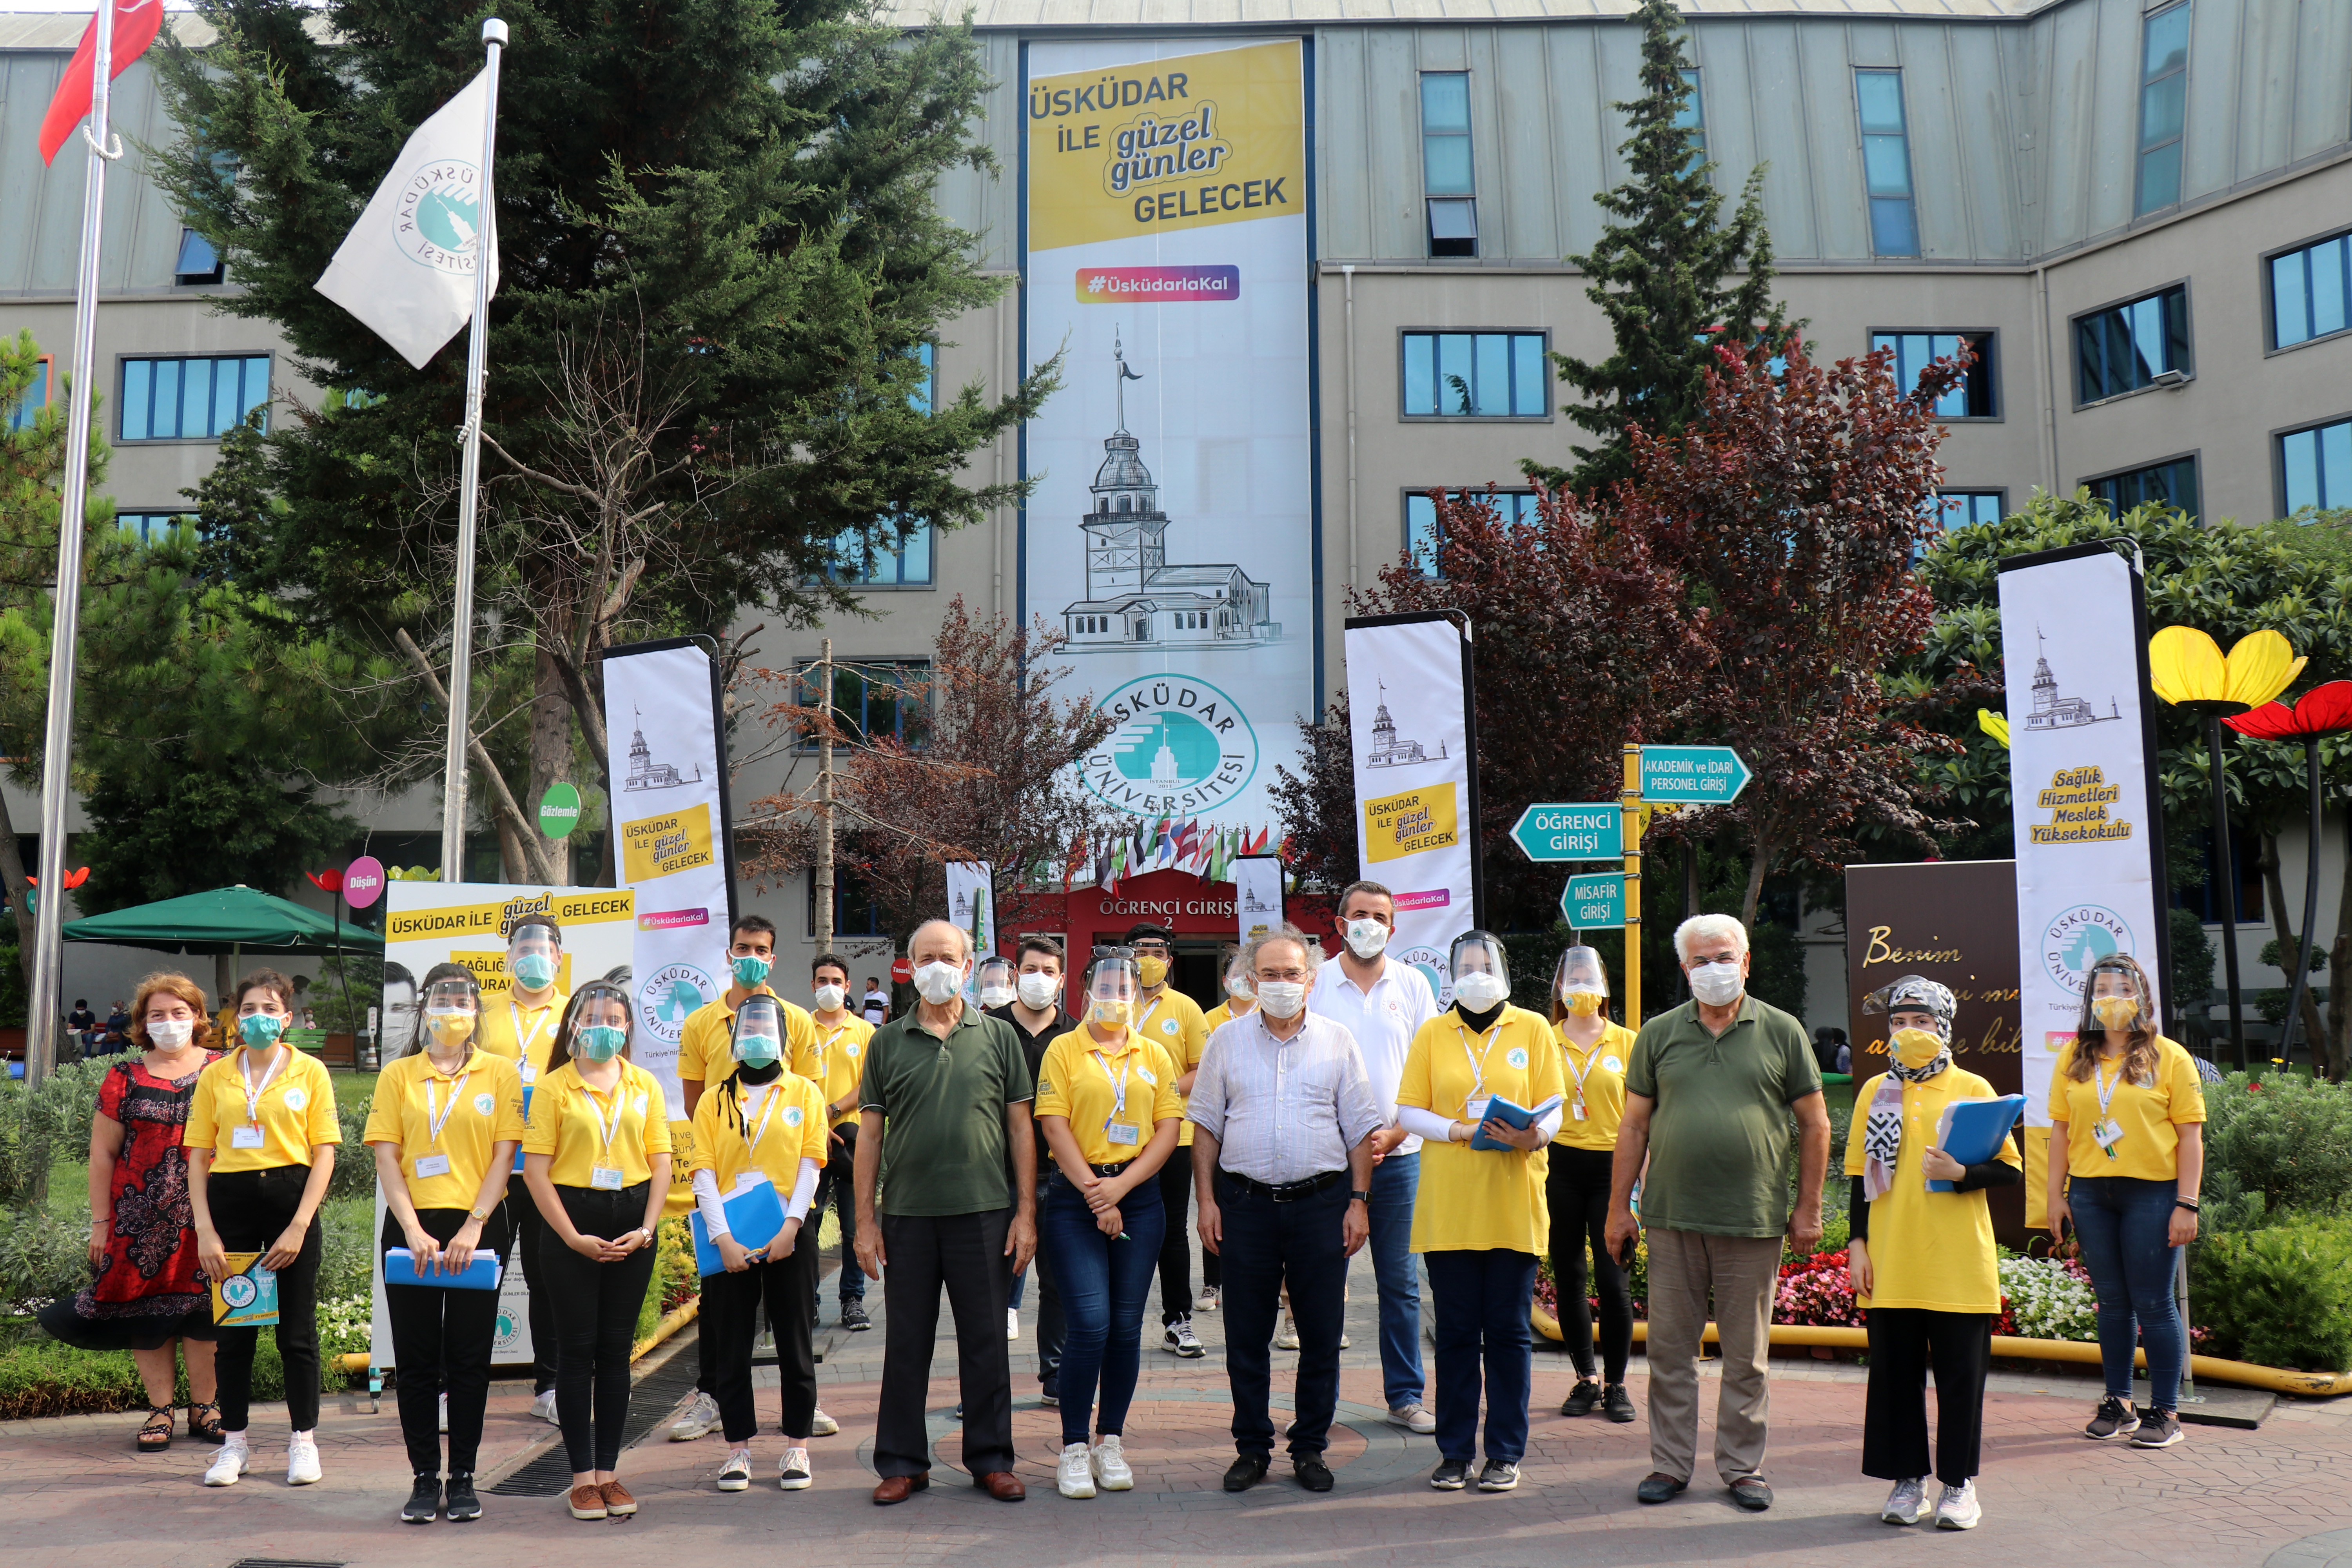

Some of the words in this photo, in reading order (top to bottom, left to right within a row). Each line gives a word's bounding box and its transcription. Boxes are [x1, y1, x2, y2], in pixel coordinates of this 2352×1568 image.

[1030, 72, 1188, 119] ÜSKÜDAR
[1058, 124, 1100, 152] İLE
[1116, 107, 1212, 160] güzel
[1111, 141, 1227, 191] günler
[1134, 177, 1287, 222] GELECEK
[1087, 276, 1228, 293] #ÜsküdarlaKal
[1644, 758, 1694, 773] AKADEMİK
[1695, 764, 1706, 773] ve
[1708, 759, 1733, 774] İDARİ
[1651, 777, 1699, 791] PERSONEL
[1700, 776, 1727, 794] GİRİŞİ
[2055, 769, 2102, 788] Sağlık
[1369, 795, 1419, 816] ÜSKÜDAR
[2040, 788, 2117, 806] Hizmetleri
[541, 804, 578, 818] Gözlemle
[1377, 817, 1392, 828] İLE
[1396, 806, 1428, 829] güzel
[1535, 812, 1611, 830] ÖĞRENCİ
[2055, 805, 2107, 823] Meslek
[626, 818, 678, 838] ÜSKÜDAR
[1396, 820, 1434, 842] günler
[2033, 822, 2129, 841] Yüksekokulu
[634, 839, 649, 849] İLE
[654, 828, 686, 851] güzel
[1404, 831, 1454, 851] GELECEK
[1550, 832, 1598, 853] GİRİŞİ
[653, 841, 690, 863] günler
[662, 851, 709, 872] GELECEK
[350, 875, 377, 889] Düşün
[1574, 882, 1617, 900] MİSAFİR
[504, 895, 549, 919] güzel
[563, 899, 630, 917] GELECEK
[1100, 897, 1180, 915] ÖĞRENCİ
[1394, 894, 1445, 907] ÜsküdarlaKal
[392, 915, 465, 933] ÜSKÜDAR
[469, 911, 492, 926] İLE
[643, 913, 704, 926] #ÜsküdarlaKal
[1580, 902, 1610, 922] GİRİŞİ
[1164, 916, 1173, 930] 2
[2049, 909, 2123, 940] ÜSKÜDAR
[1862, 925, 1962, 968] Benim
[646, 967, 707, 995] ÜSKÜDAR
